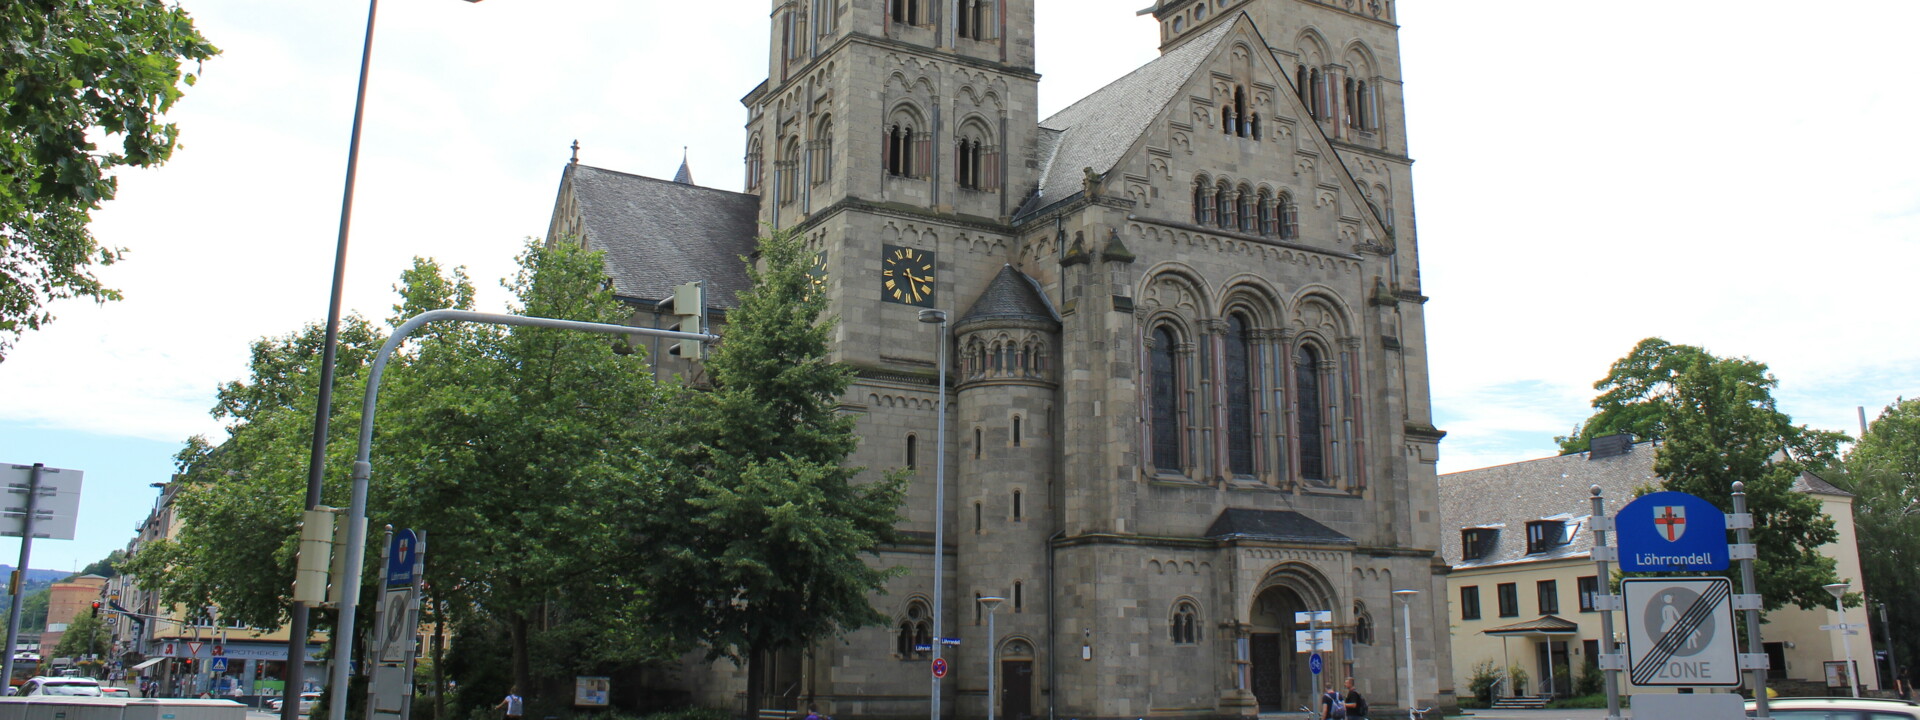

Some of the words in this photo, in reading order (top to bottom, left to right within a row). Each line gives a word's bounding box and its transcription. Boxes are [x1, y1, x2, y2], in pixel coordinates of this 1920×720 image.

[1636, 552, 1712, 565] Löhrrondell
[225, 648, 279, 657] POTHEKE
[1658, 661, 1712, 679] ZONE
